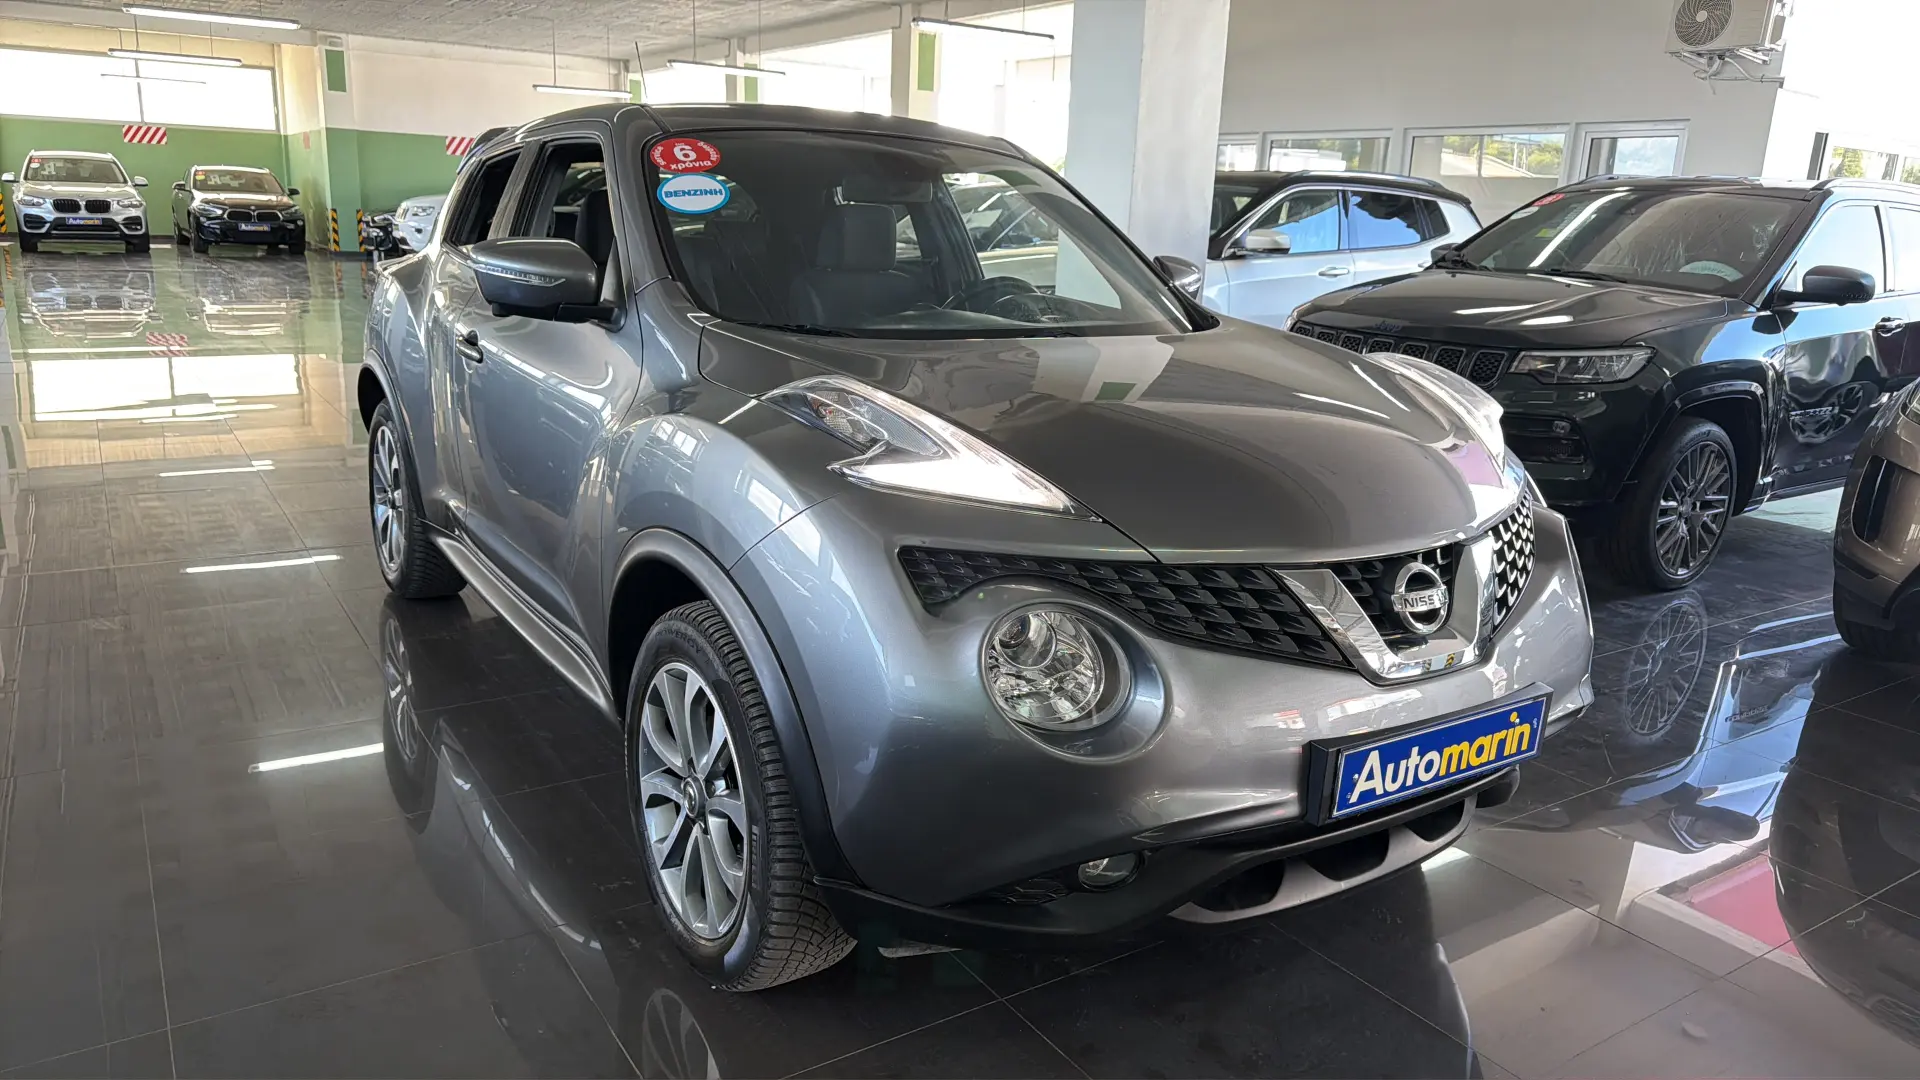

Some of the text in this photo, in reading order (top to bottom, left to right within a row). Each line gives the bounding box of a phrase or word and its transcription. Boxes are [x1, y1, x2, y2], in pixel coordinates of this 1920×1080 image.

[673, 145, 697, 161] 6
[670, 160, 712, 170] χρόνια
[1349, 711, 1531, 804] Automarin
